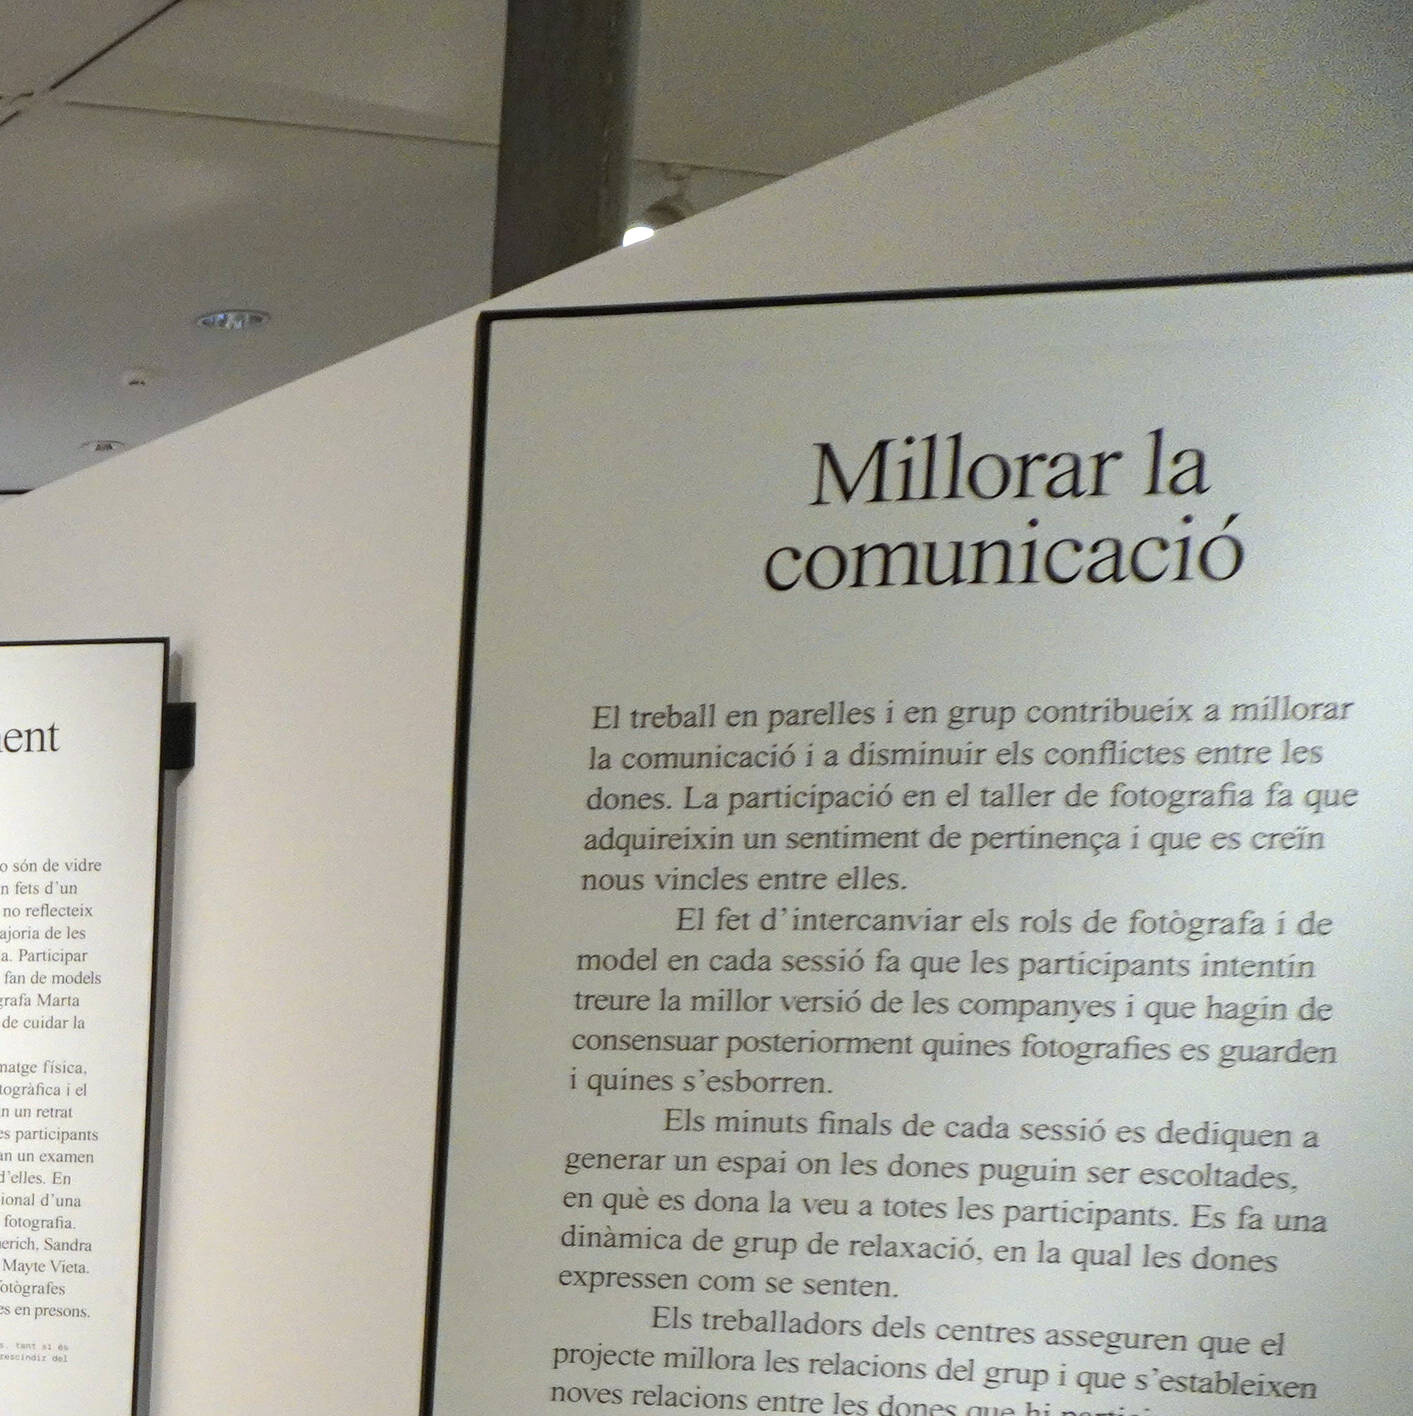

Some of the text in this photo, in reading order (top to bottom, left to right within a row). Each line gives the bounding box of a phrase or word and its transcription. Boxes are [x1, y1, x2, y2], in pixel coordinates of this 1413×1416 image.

[809, 427, 1211, 506] Millorar la
[764, 512, 1245, 592] comunicació
[592, 694, 1355, 734] El treball en parelles i en grup contribueix a millorar
[12, 858, 37, 873] són
[42, 857, 59, 872] de
[64, 857, 102, 872] vidre
